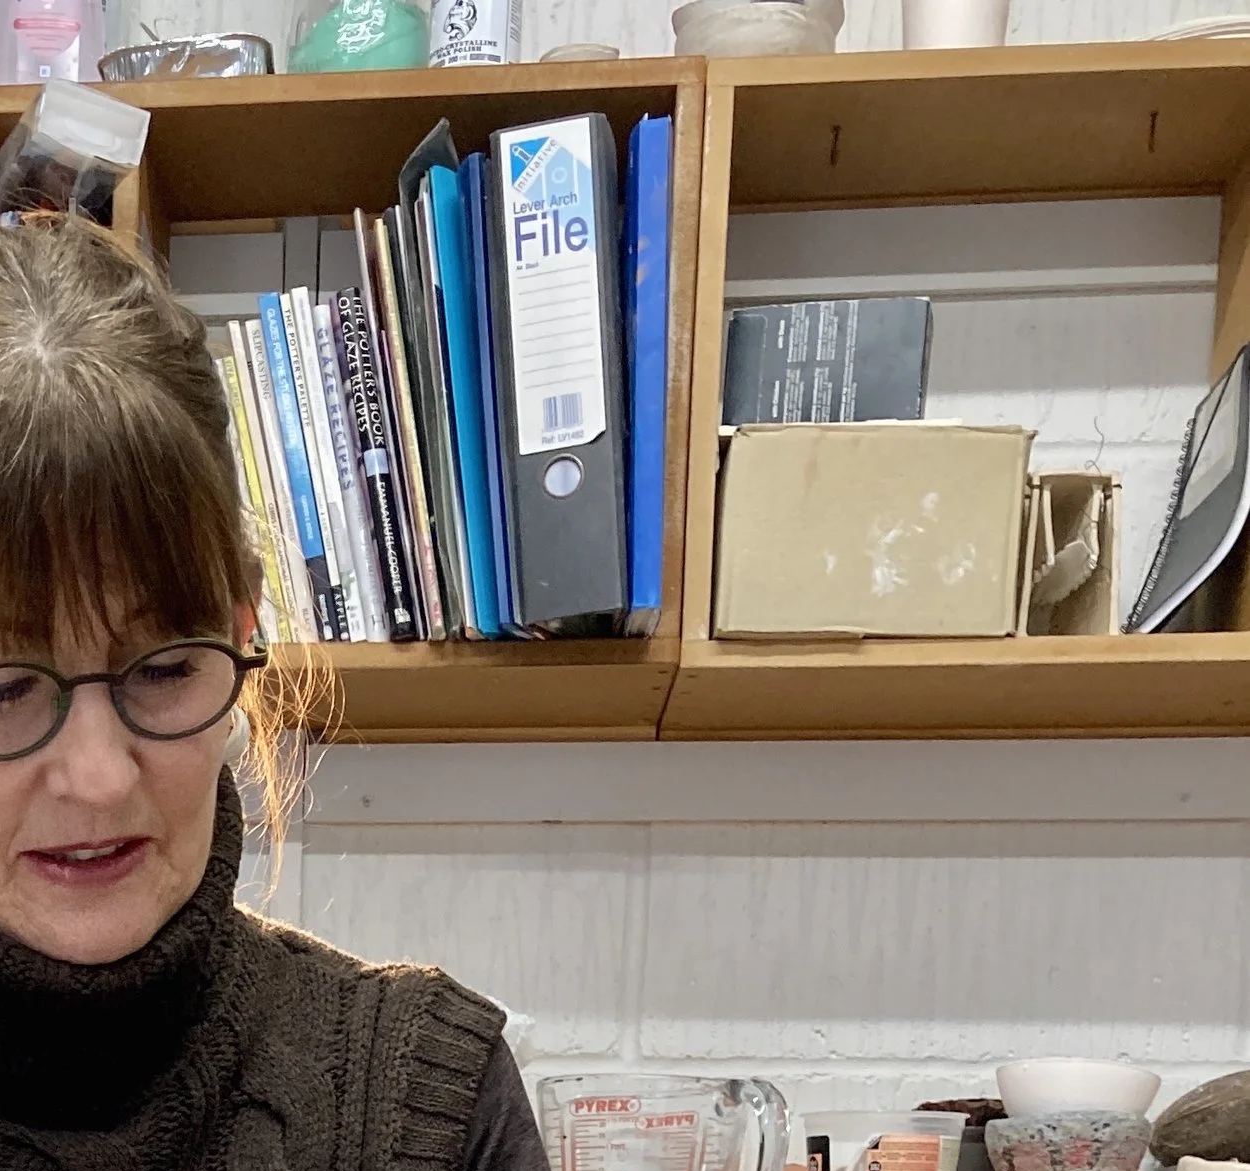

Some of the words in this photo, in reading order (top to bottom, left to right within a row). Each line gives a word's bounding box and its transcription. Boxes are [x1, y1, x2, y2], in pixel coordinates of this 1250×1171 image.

[513, 199, 546, 215] Lever
[550, 192, 578, 208] Arch
[514, 209, 589, 262] File
[265, 307, 280, 340] GLAZES
[284, 309, 294, 329] THE
[337, 295, 352, 317] OF
[351, 295, 366, 326] THE
[251, 329, 272, 401] SLIPCASTING
[288, 332, 303, 381] POTTER'S
[341, 321, 361, 371] GLAZE
[356, 330, 378, 397] POTTER'S
[297, 383, 311, 428] PALETTE
[316, 327, 338, 395] GLAZE
[328, 403, 355, 491] RECIPES
[349, 374, 371, 433] RECIPES
[368, 402, 385, 447] BOOK
[375, 481, 396, 549] EMMANUEL
[386, 549, 403, 594] COOPER
[575, 1099, 631, 1114] PYREX
